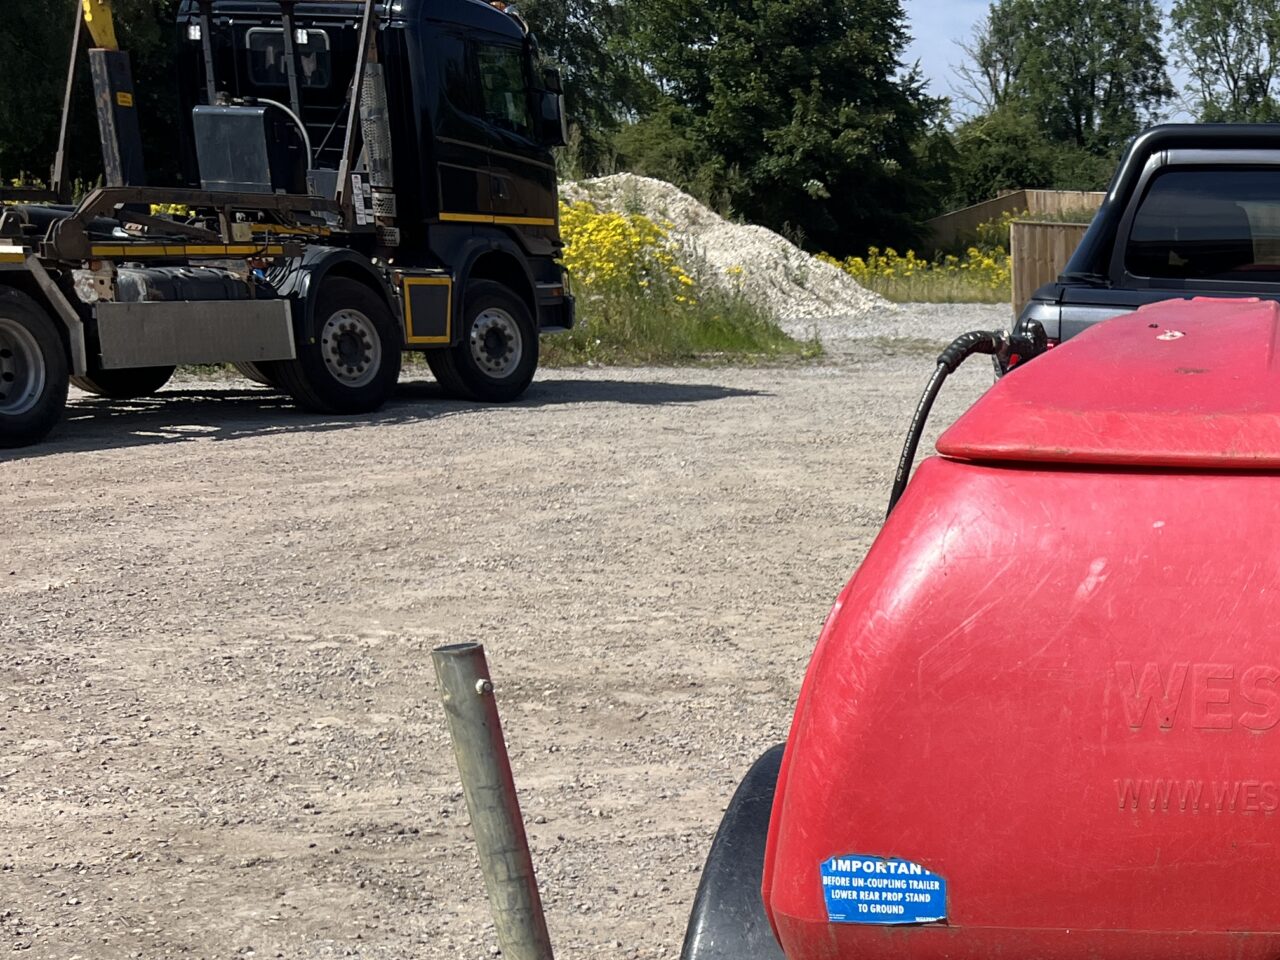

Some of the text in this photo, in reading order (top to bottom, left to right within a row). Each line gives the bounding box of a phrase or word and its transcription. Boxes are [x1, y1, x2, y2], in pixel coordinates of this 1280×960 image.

[822, 875, 940, 890] BEFORE UN-COUPLING TRAILER
[831, 889, 931, 903] LOWER REAR PROP STAND
[858, 903, 905, 914] TO GROUND
